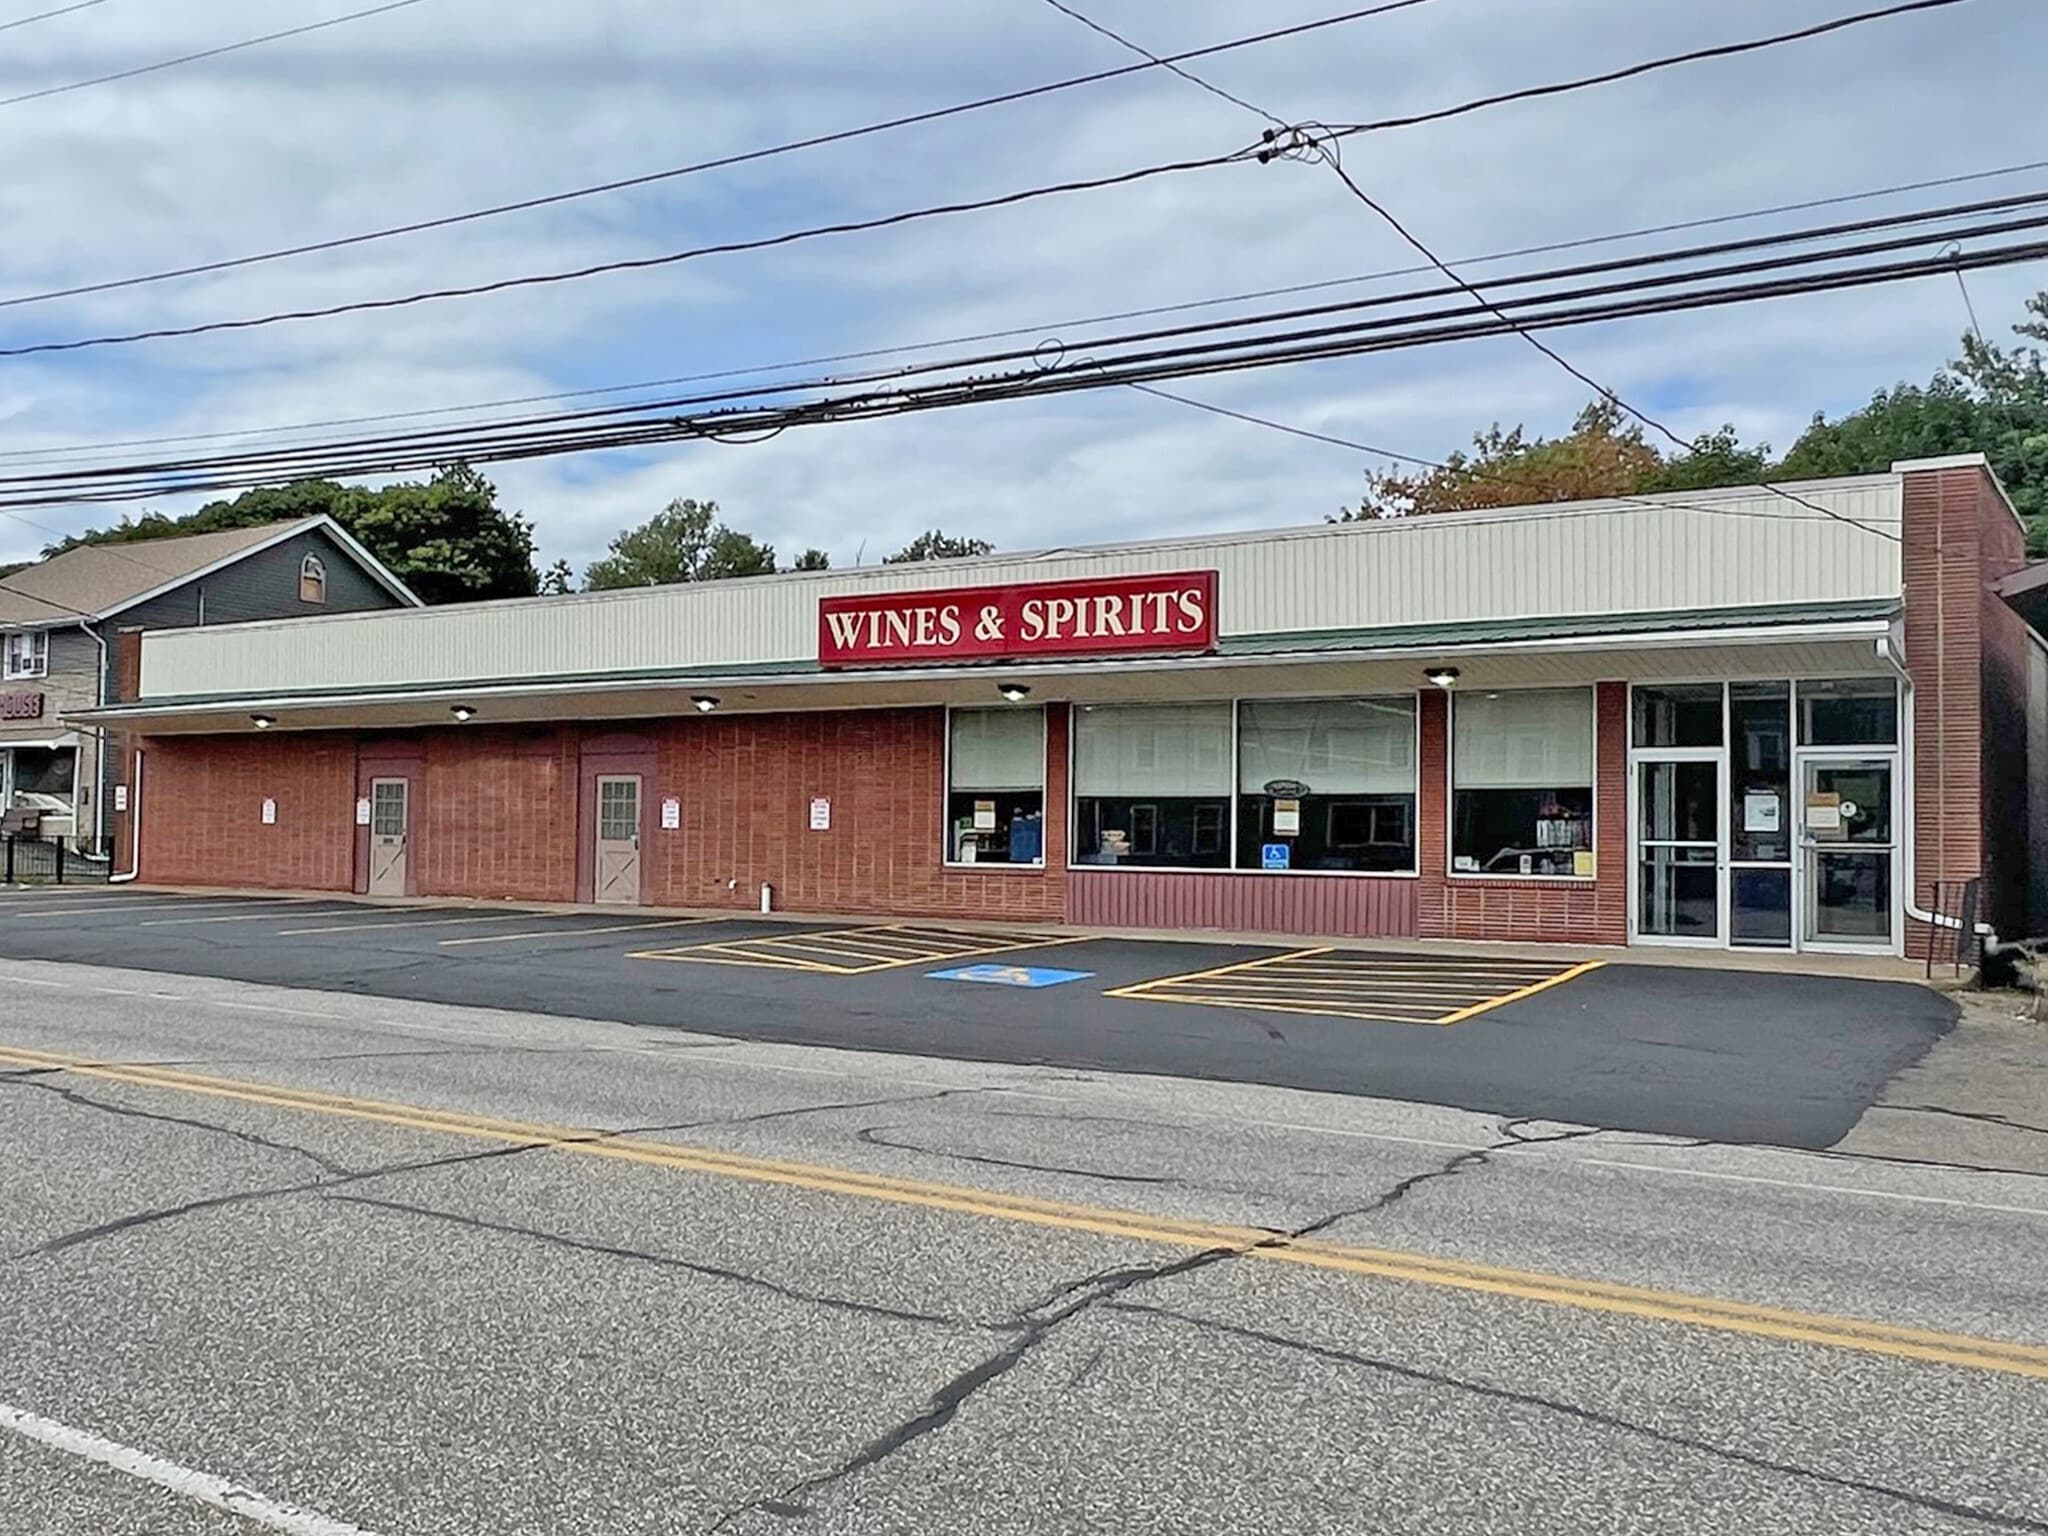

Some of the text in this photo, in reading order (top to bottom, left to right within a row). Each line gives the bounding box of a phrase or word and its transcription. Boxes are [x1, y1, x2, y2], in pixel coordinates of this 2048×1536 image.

[825, 588, 1204, 650] WINES & SPIRITS
